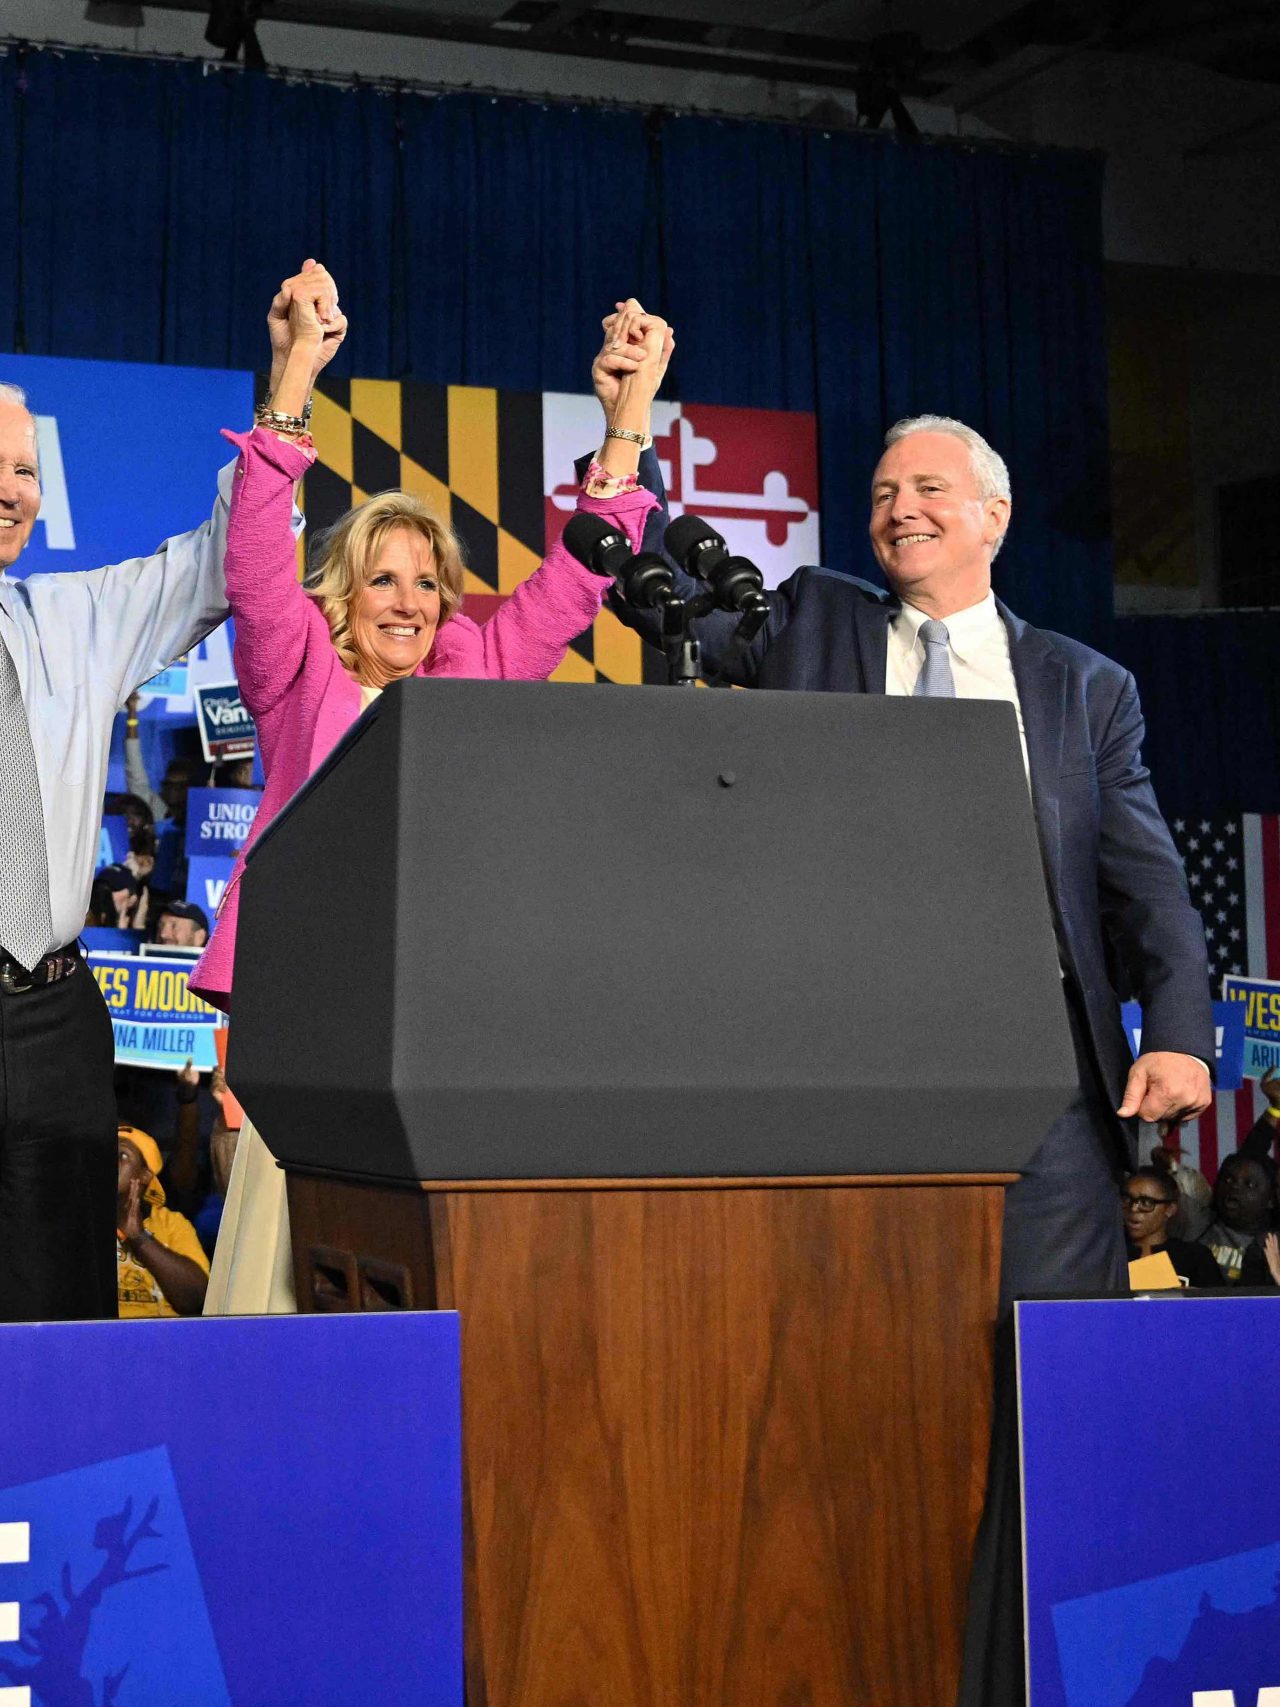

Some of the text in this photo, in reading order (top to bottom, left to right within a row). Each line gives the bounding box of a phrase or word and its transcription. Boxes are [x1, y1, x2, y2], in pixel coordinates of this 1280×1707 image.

[204, 704, 249, 727] Van
[208, 802, 258, 821] UNIO
[200, 821, 251, 840] STRO
[142, 1027, 196, 1053] MILLER
